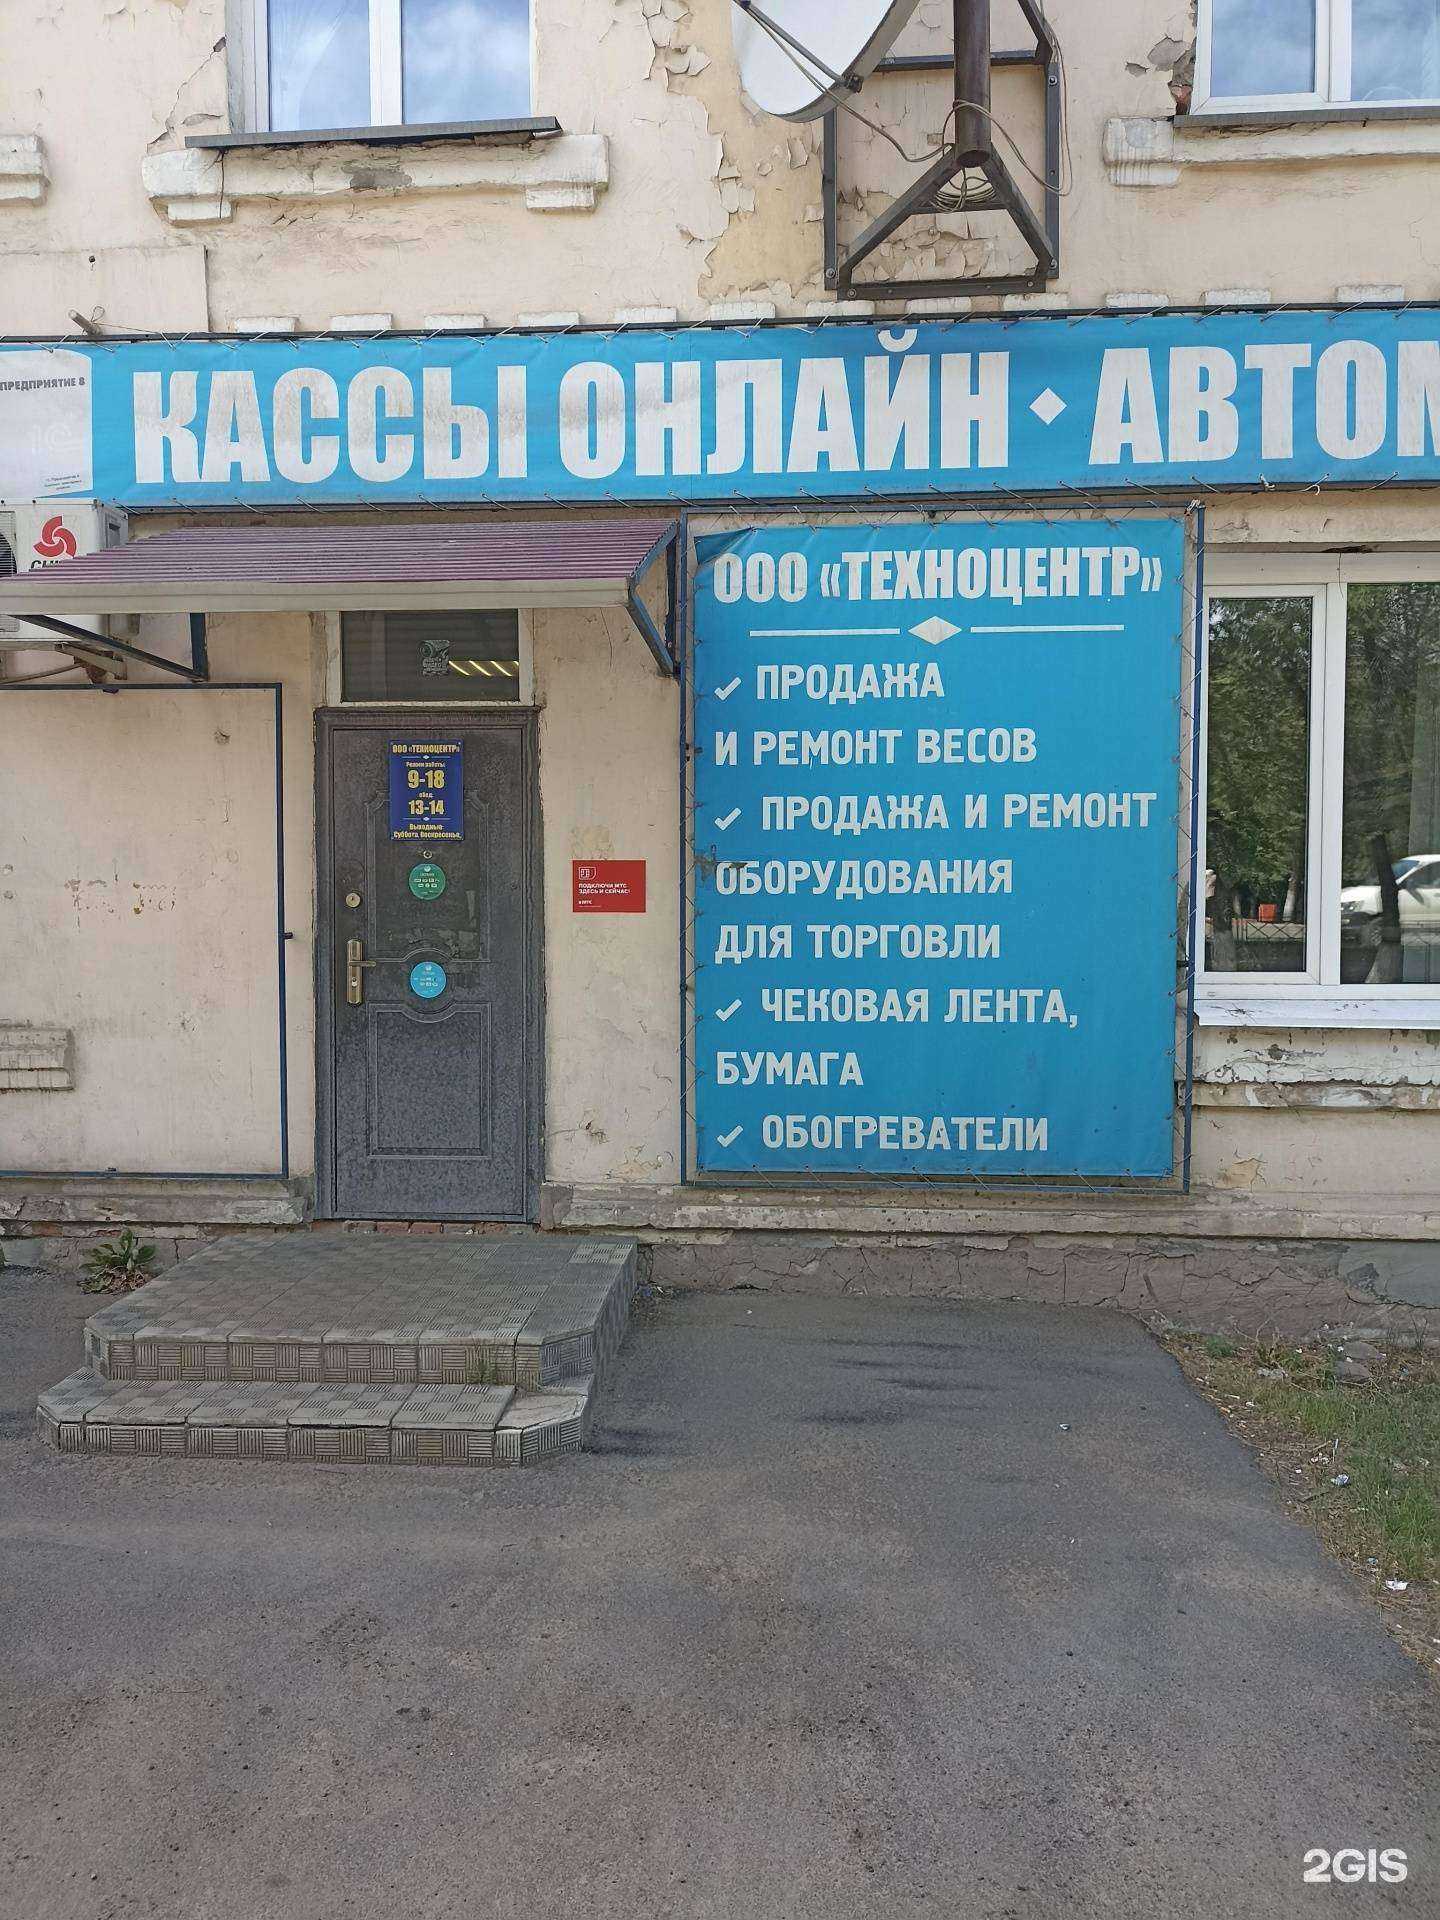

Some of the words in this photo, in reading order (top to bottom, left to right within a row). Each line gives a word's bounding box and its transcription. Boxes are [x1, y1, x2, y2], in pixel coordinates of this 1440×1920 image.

[0, 378, 76, 391] ПРЕДПРИЯТИЕ
[79, 377, 86, 386] 8
[133, 366, 527, 484] КАССЫ
[559, 328, 1009, 480] ОНЛАЙН
[713, 552, 808, 603] ООО
[820, 547, 1163, 605] «ТЕХНОЦЕНТР»
[757, 663, 945, 705] ПРОДАЖА
[715, 732, 737, 766] И
[754, 730, 903, 766] РЕМОНТ
[917, 728, 1037, 764] ВЕСОВ
[407, 769, 445, 788] 9-18
[408, 800, 445, 815] 13-14
[762, 795, 950, 836] ПРОДАЖА
[965, 795, 987, 829] И
[1004, 793, 1157, 828] РЕМОНТ
[715, 860, 1013, 900] ОБОРУДОВАНИЯ
[714, 925, 792, 965] ДЛЯ
[807, 924, 1000, 959] ТОРГОВЛИ
[761, 989, 929, 1023] ЧЕКОВАЯ
[944, 989, 1078, 1028] ЛЕНТА,
[716, 1052, 864, 1086] БУМАГА
[762, 1115, 1048, 1151] ОБОГРЕВАТЕЛИ
